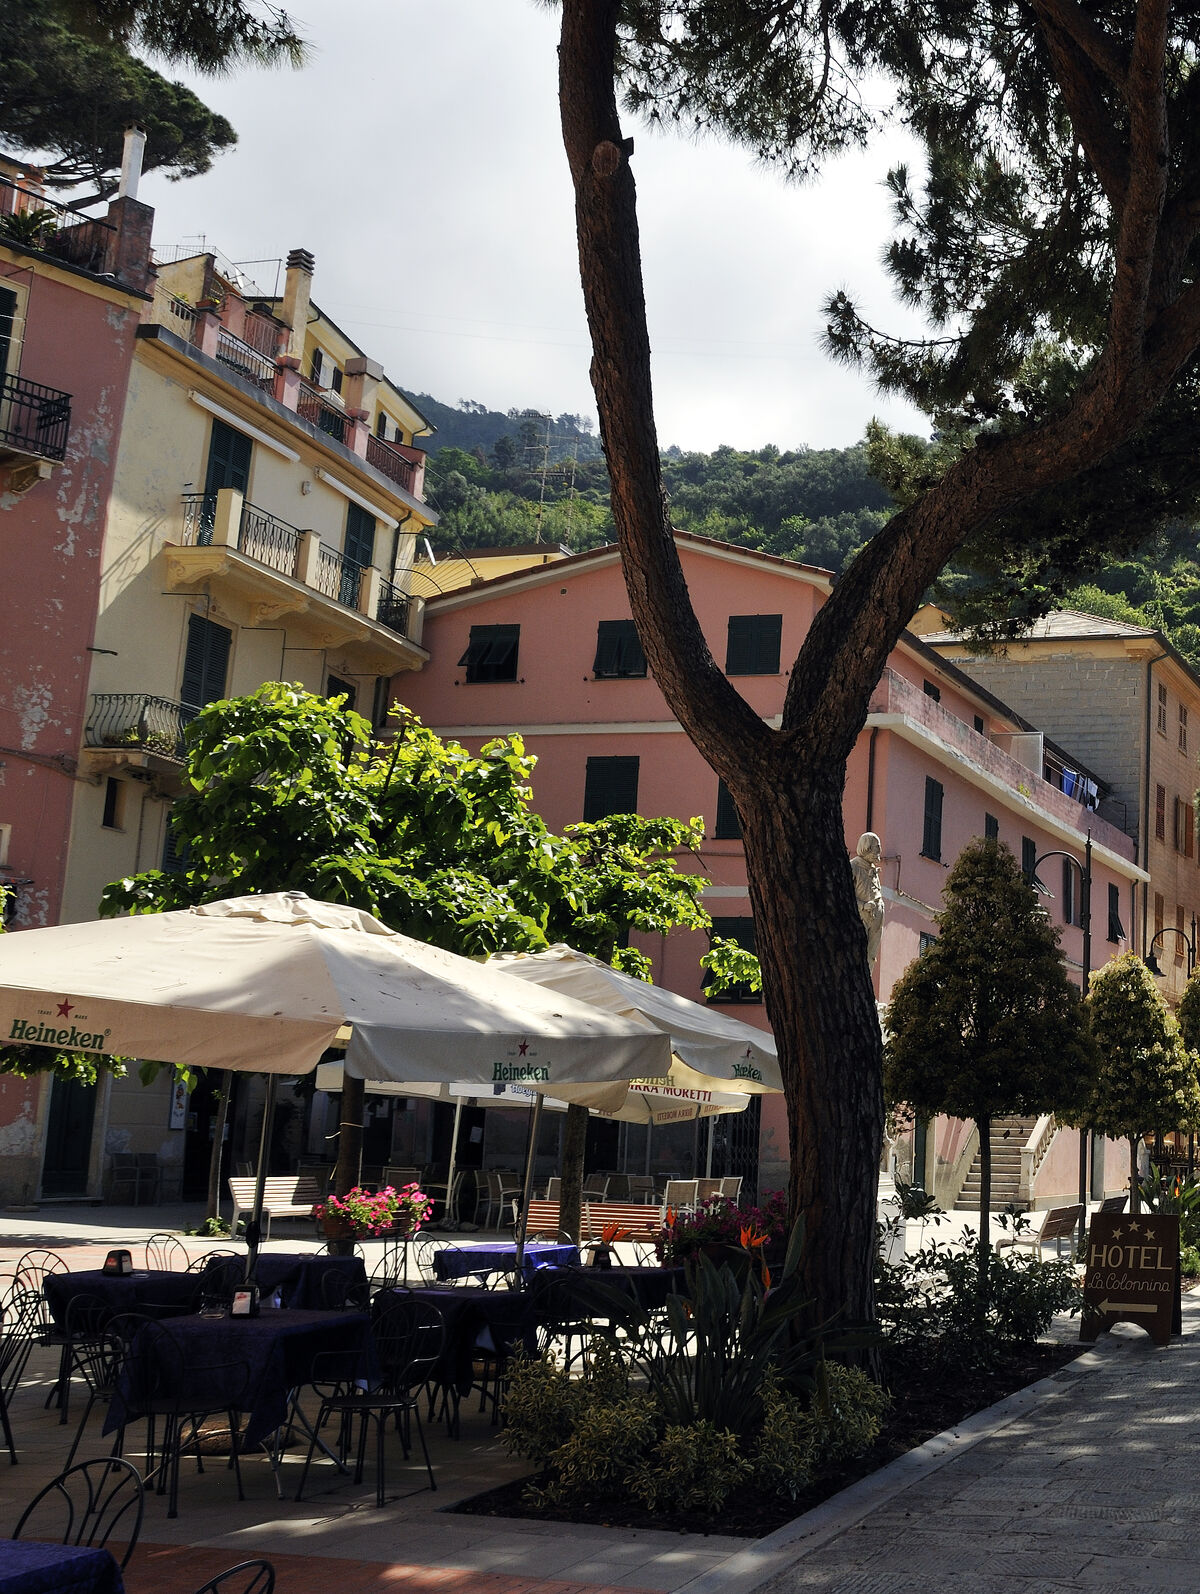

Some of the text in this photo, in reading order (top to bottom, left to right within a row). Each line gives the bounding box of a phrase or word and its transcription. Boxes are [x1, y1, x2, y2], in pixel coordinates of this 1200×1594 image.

[9, 1019, 105, 1050] Heineken
[492, 1062, 549, 1081] Heineken
[663, 1087, 712, 1102] MORETTI
[1090, 1244, 1173, 1270] HOTEL
[1088, 1272, 1171, 1292] La Colonnina
